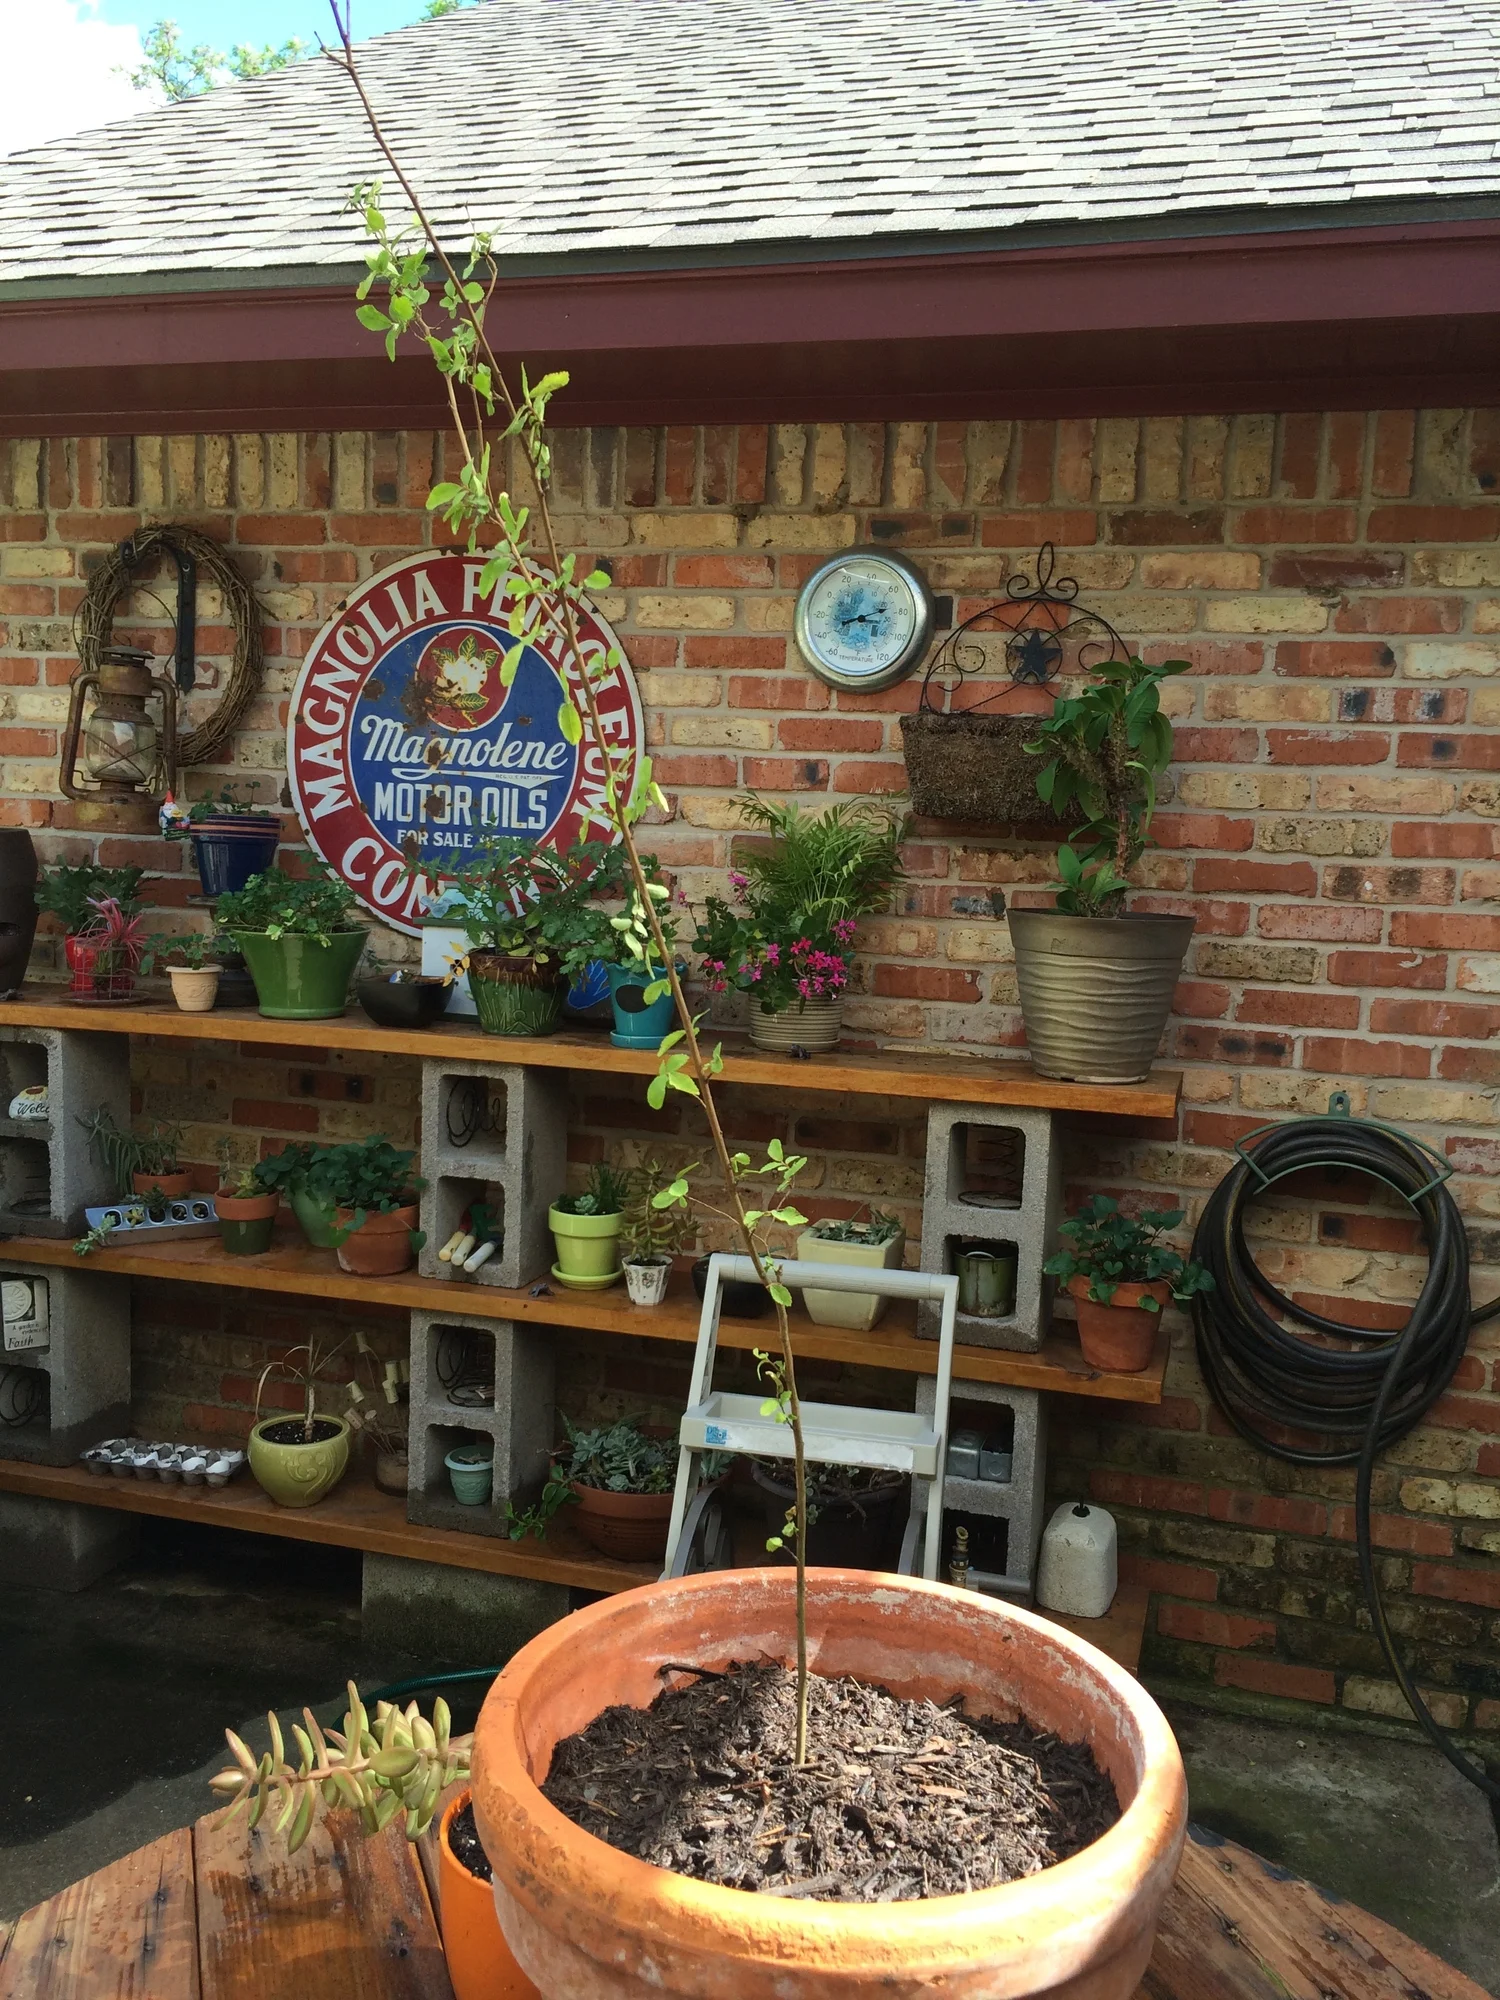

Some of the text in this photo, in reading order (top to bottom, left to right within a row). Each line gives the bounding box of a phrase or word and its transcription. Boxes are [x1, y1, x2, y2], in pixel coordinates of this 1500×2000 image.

[841, 575, 852, 583] 20
[888, 585, 899, 593] 60
[827, 591, 832, 599] 0
[813, 610, 826, 619] -20
[898, 608, 908, 616] 80
[814, 631, 827, 640] -40
[894, 633, 908, 642] 100
[825, 648, 839, 656] -60
[876, 653, 890, 661] 120
[300, 564, 637, 833] MAGNOLIA PETROLEUM
[360, 714, 569, 781] Magnolene
[374, 782, 548, 830] MOTOR OILS
[396, 829, 429, 846] FOR
[432, 831, 474, 849] SALE
